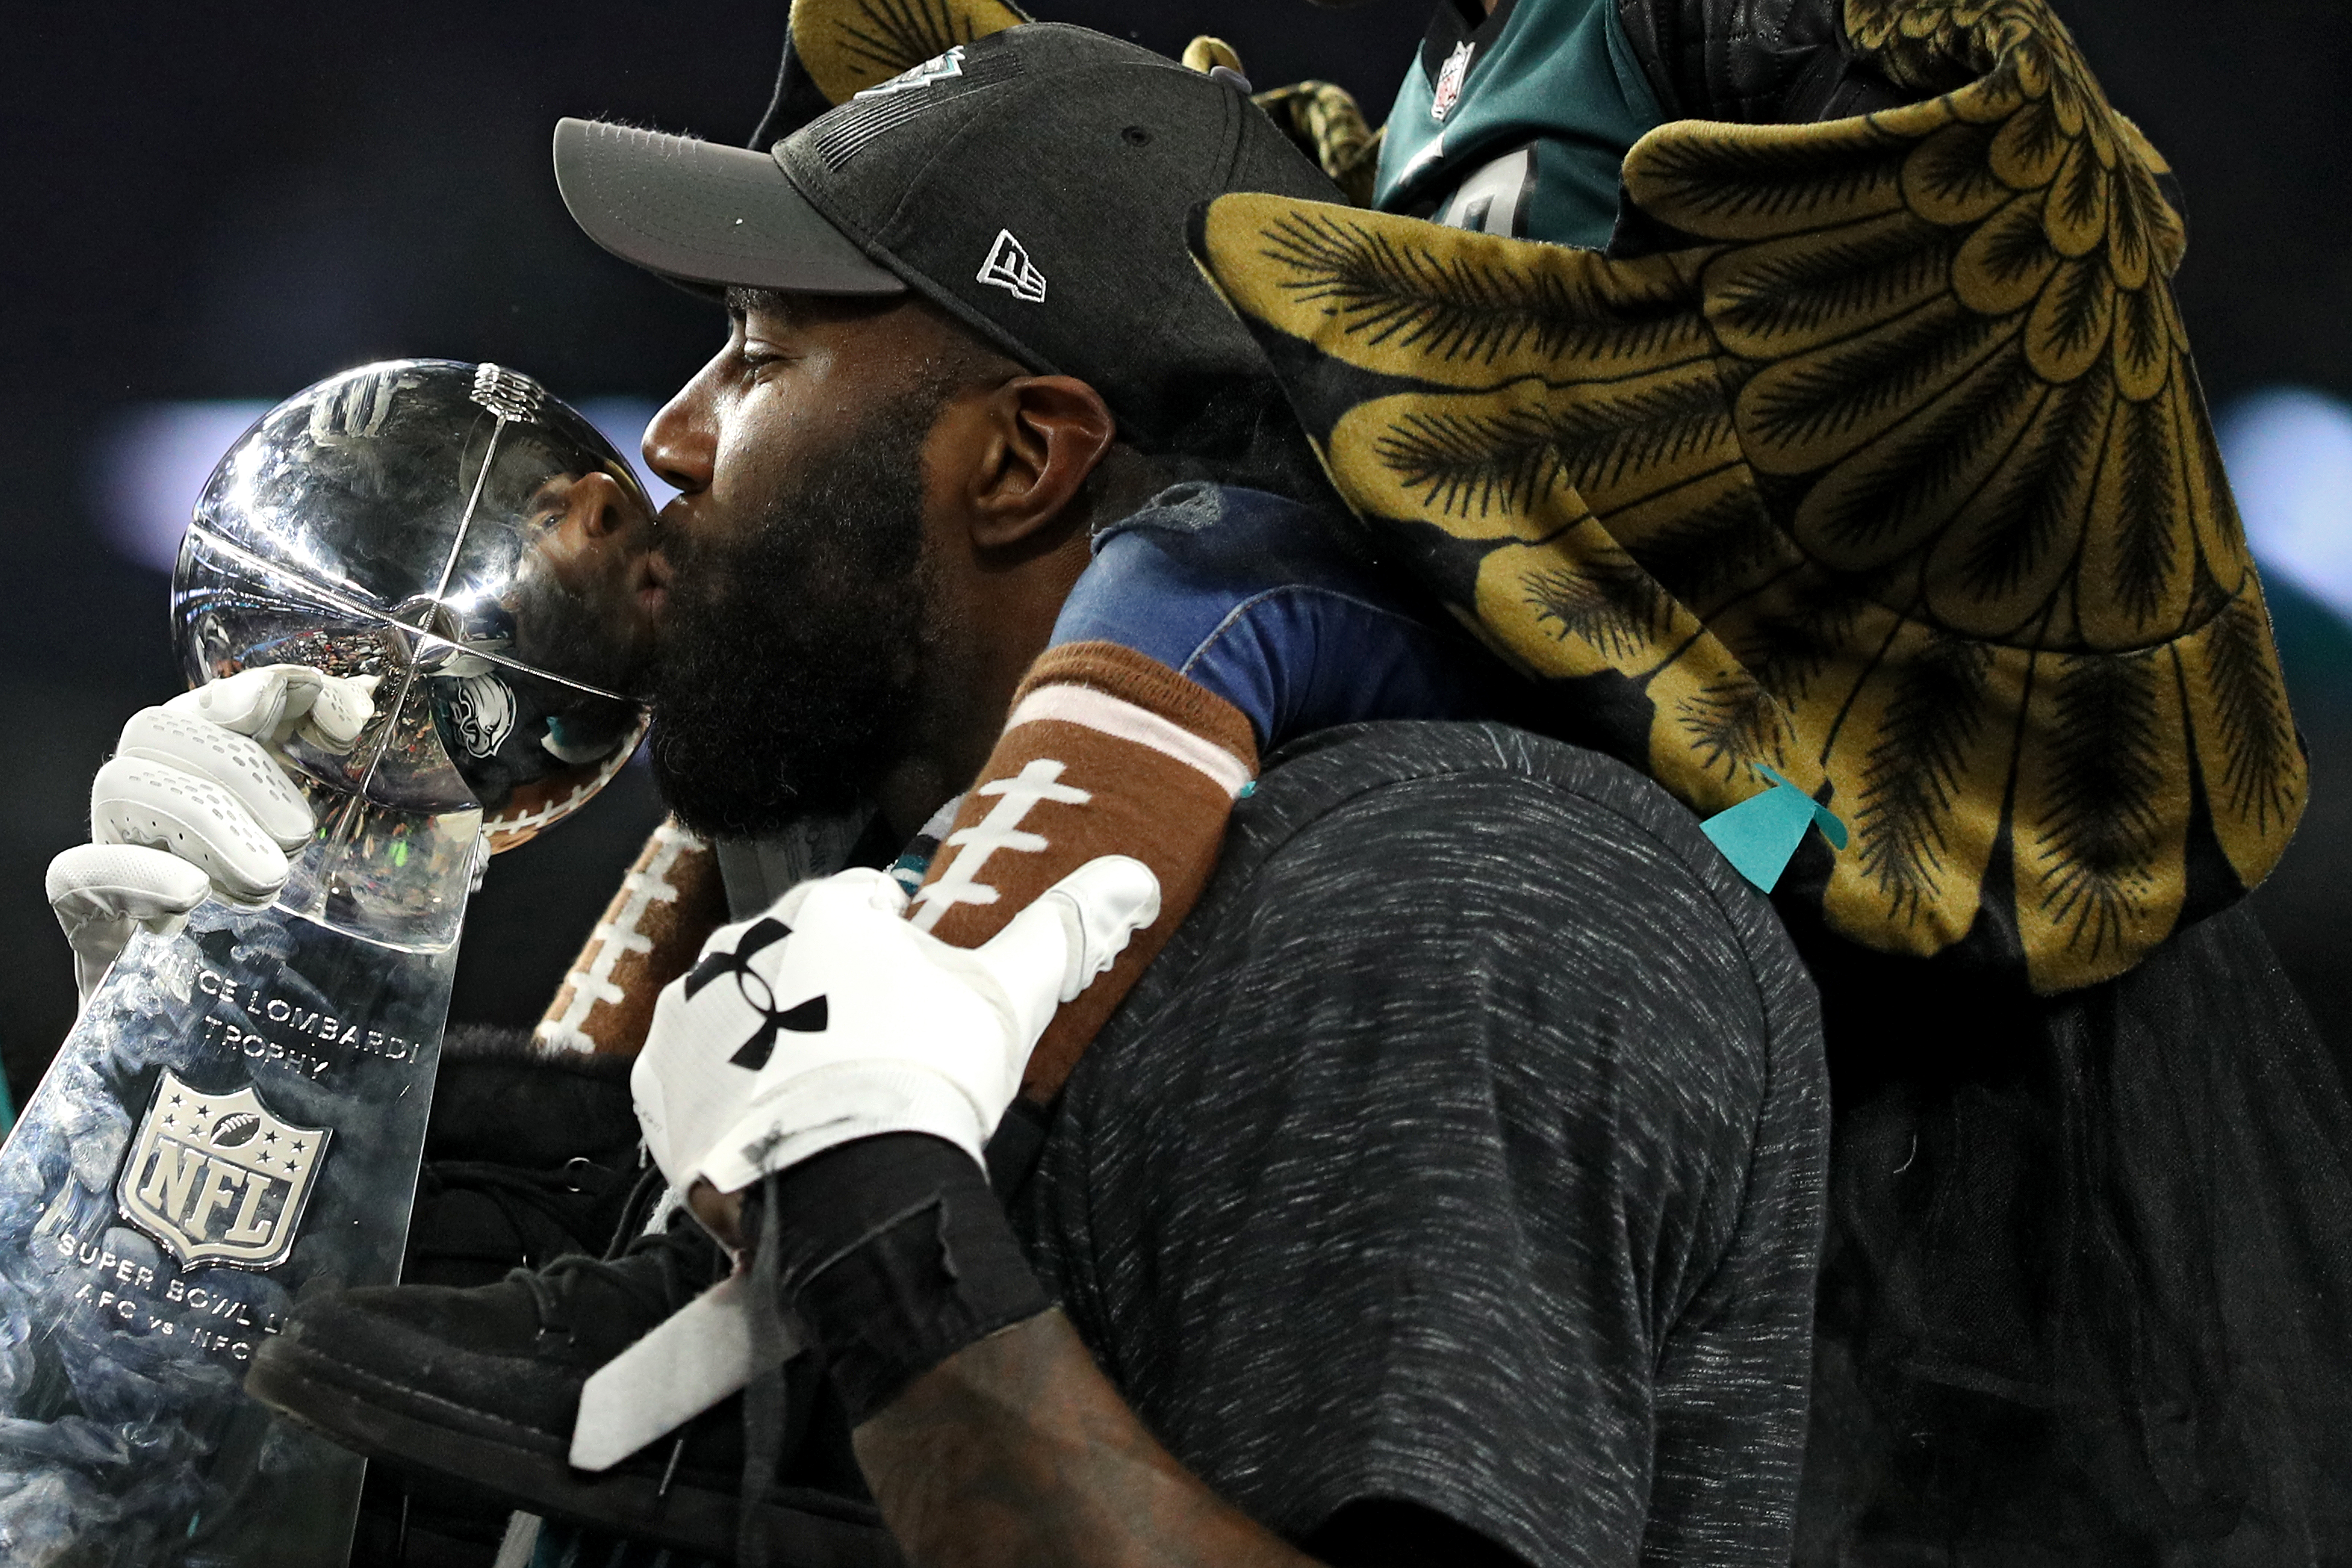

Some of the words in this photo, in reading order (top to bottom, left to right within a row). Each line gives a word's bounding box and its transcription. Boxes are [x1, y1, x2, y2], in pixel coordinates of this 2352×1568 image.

[205, 1014, 329, 1079] TROPHY
[248, 990, 419, 1064] LOMBARDI
[139, 1137, 272, 1244] NFL
[58, 1234, 154, 1290] SUPER
[166, 1279, 250, 1326] BOWL
[75, 1284, 137, 1318] AFC
[191, 1327, 250, 1360] NFC
